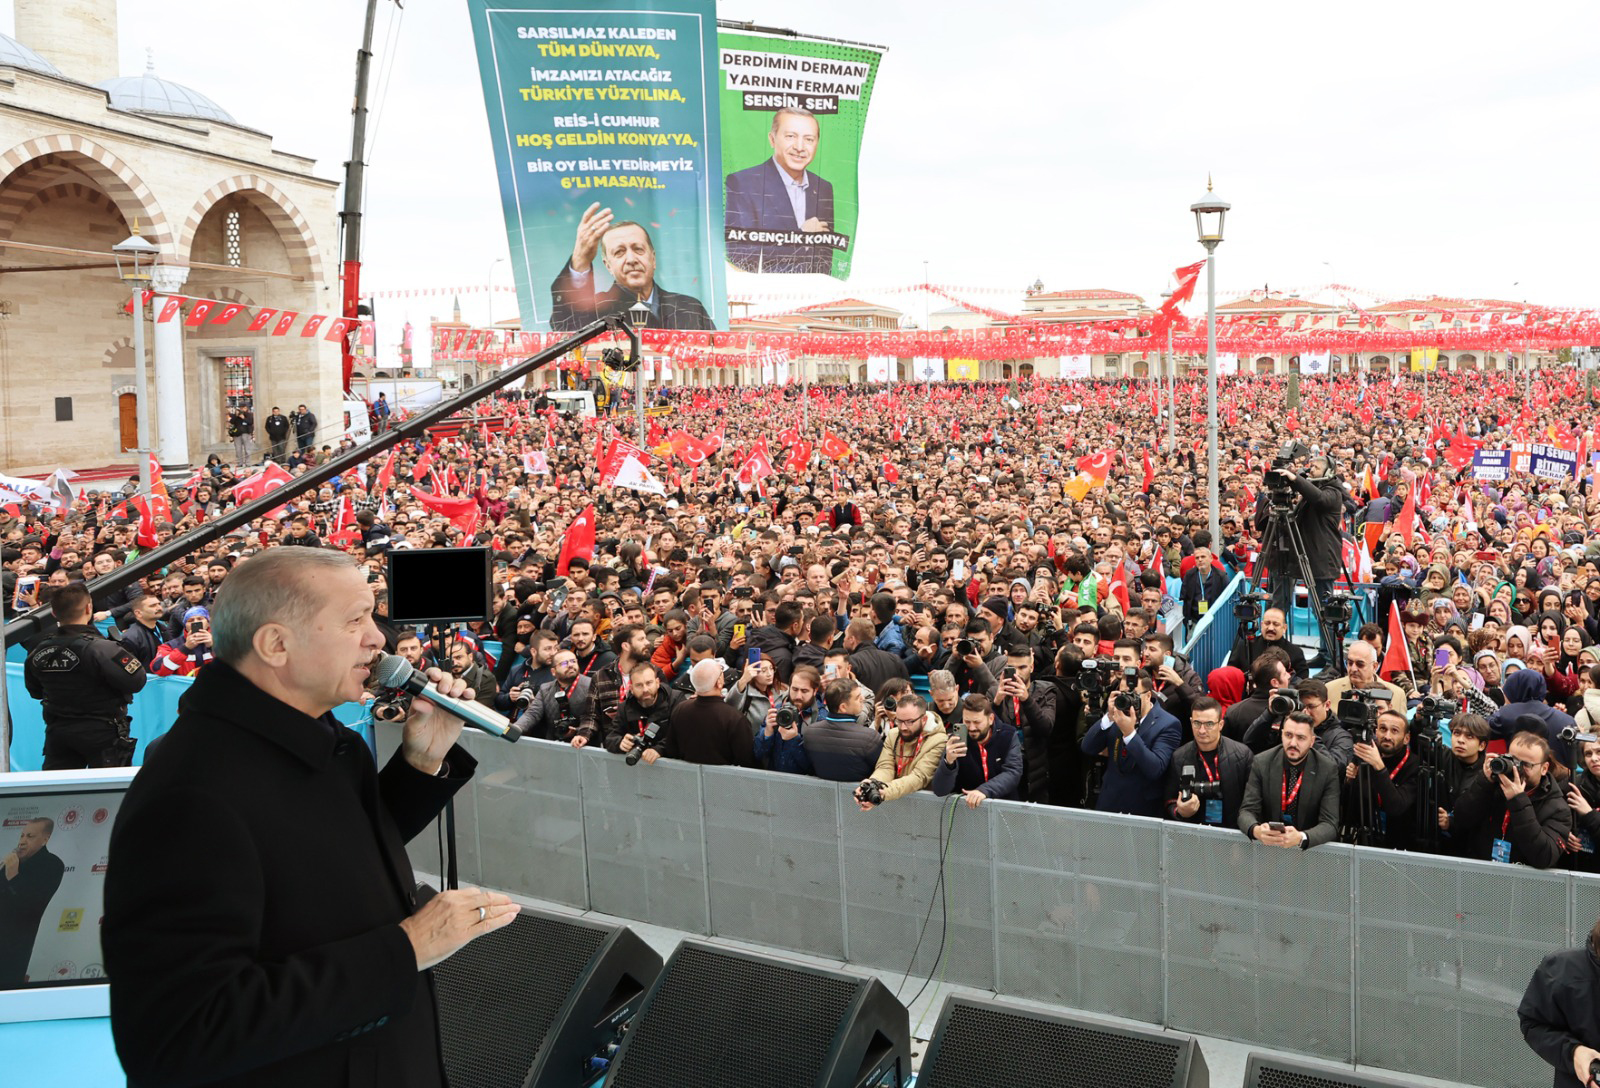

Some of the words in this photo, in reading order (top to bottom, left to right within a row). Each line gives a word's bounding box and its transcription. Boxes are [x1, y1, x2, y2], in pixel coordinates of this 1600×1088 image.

[517, 26, 606, 39] SARSILMAZ
[608, 27, 676, 41] KALEDEN
[537, 41, 577, 57] TÜM
[578, 41, 660, 60] DÜNYAYA,
[723, 53, 798, 71] DERDİMİN
[530, 66, 602, 82] İMZAMIZI
[604, 67, 672, 82] ATACAĞIZ
[729, 73, 793, 90] YARININ
[796, 80, 860, 96] FERMANI
[519, 84, 595, 102] TÜRKİYE
[595, 84, 686, 103] YÜZYILINA,
[744, 93, 803, 109] SENSİN,
[805, 98, 838, 110] SEN.
[553, 112, 600, 128] REİS-İ
[601, 115, 660, 128] CUMHUR
[516, 133, 553, 150] HOŞ
[555, 129, 616, 146] GELDİN
[617, 132, 698, 148] KONYA'YA,
[527, 158, 554, 173] BİR
[555, 160, 577, 172] OY
[578, 157, 611, 172] BİLE
[611, 157, 694, 172] YEDİRMEYİZ
[560, 175, 591, 189] 6'LI
[728, 229, 748, 241] AK
[748, 231, 803, 246] GENÇLİK
[805, 235, 846, 248] KONYA
[1532, 444, 1545, 456] BU
[1546, 447, 1577, 462] SEVDA
[1536, 458, 1570, 474] BİTMEZ
